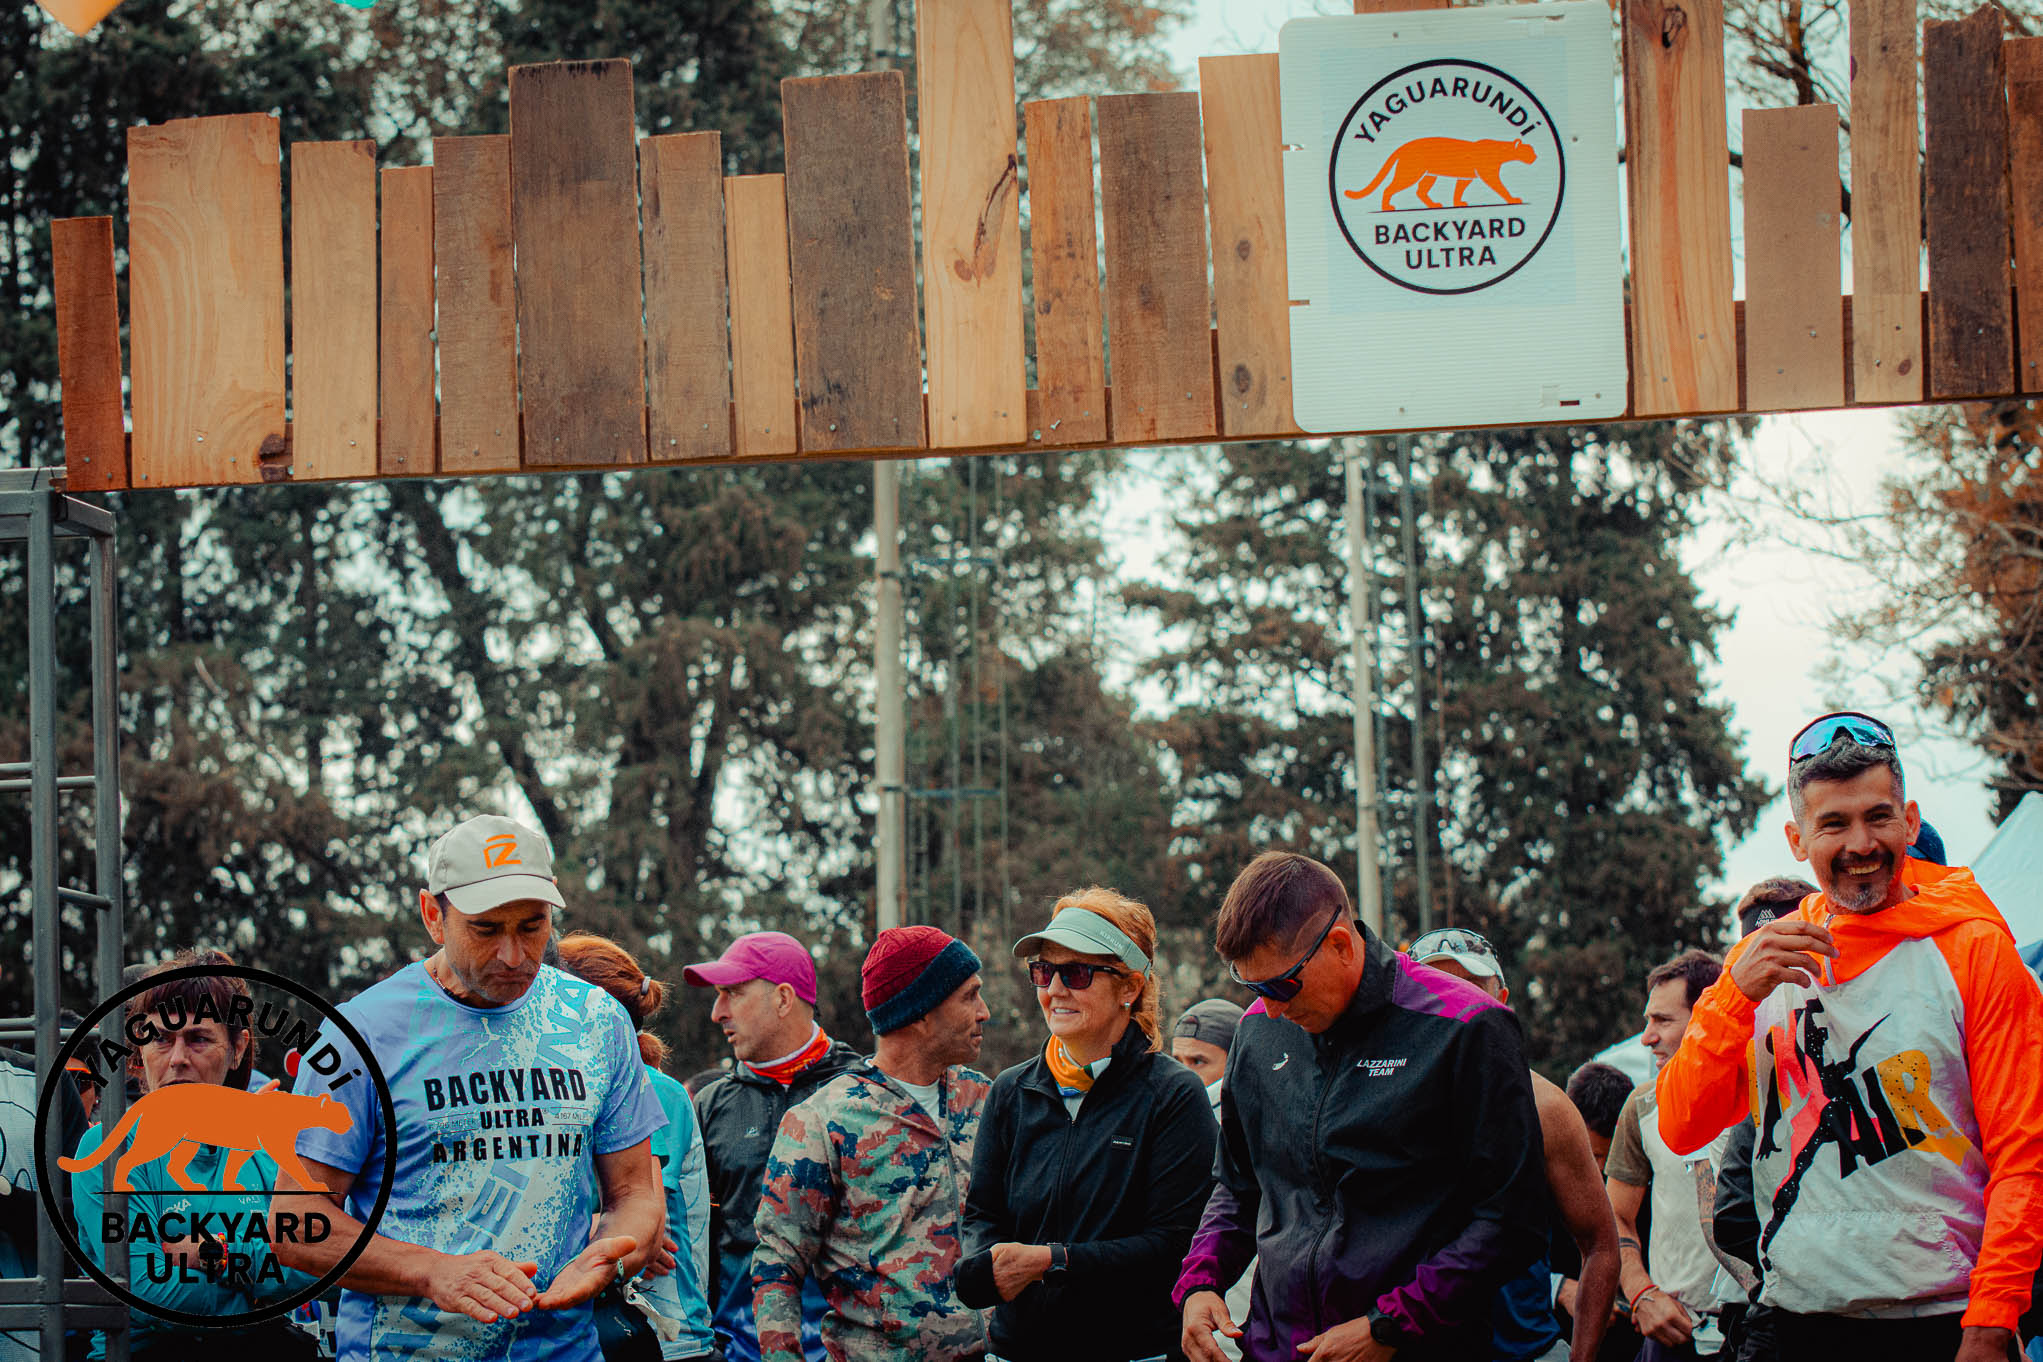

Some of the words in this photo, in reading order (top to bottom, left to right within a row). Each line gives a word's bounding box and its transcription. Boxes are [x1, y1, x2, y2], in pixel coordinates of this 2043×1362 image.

[1374, 217, 1526, 245] BACKYARD
[1405, 246, 1497, 270] ULTRA
[1356, 1058, 1407, 1068] LAZZARINI
[1368, 1067, 1394, 1077] TEAM
[424, 1068, 587, 1111] BACKYARD
[480, 1108, 544, 1129] ULTRA
[433, 1133, 582, 1163] ARGENTINA
